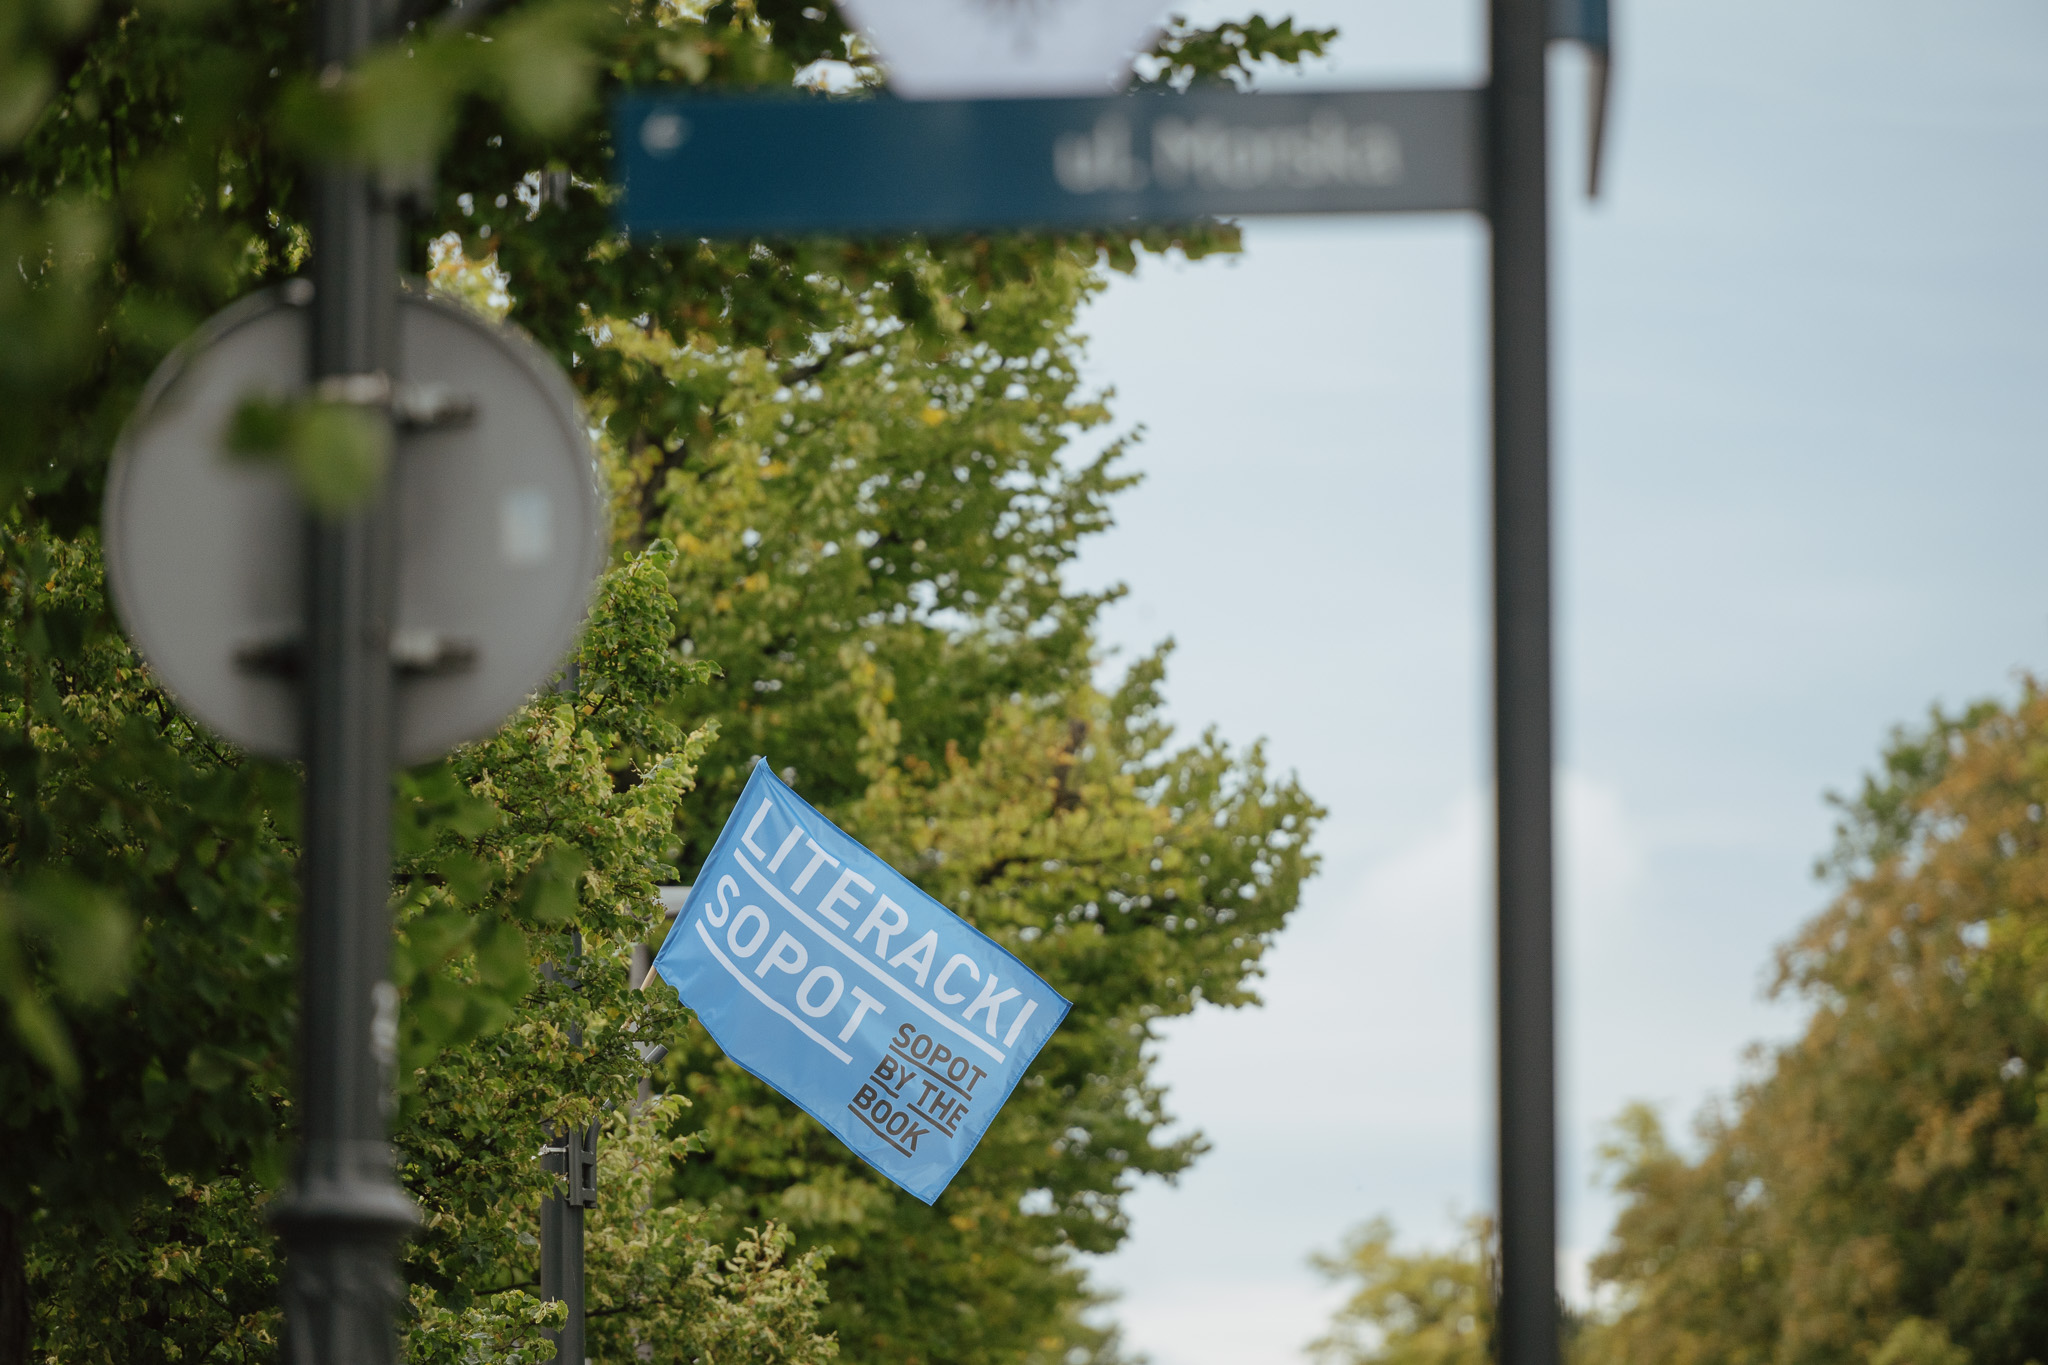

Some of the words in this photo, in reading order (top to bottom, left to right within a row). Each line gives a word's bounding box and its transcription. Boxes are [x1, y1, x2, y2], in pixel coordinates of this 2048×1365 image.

[705, 874, 887, 1044] SOPOT
[740, 797, 1039, 1049] LITERACKI
[873, 1054, 917, 1092] BY
[915, 1079, 969, 1132] THE
[892, 1022, 988, 1093] SOPOT
[852, 1083, 930, 1153] BOOK
